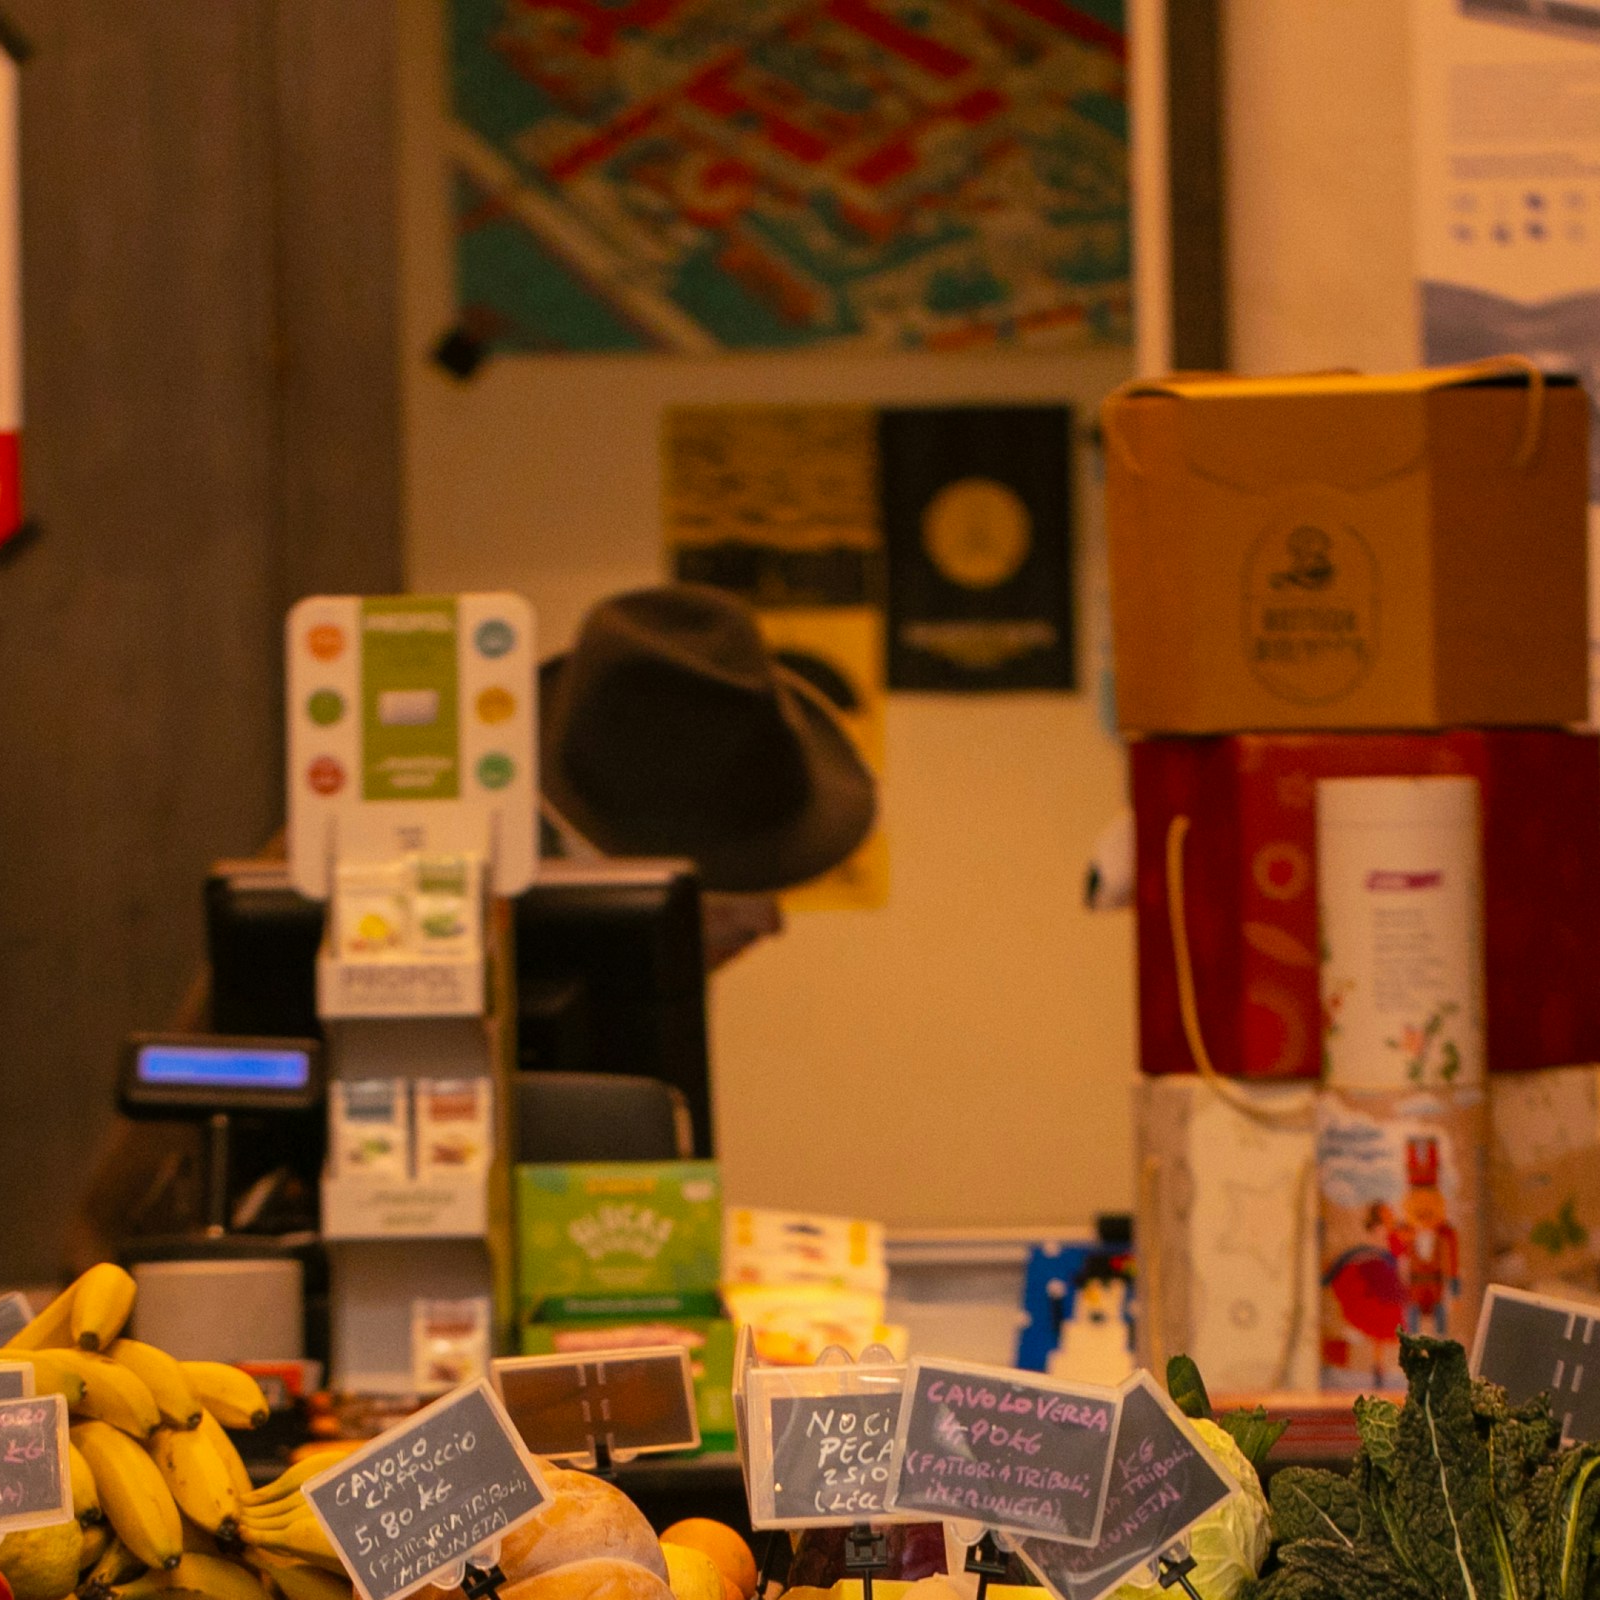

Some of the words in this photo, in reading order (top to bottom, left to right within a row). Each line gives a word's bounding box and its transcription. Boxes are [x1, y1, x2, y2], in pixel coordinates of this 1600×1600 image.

[926, 1380, 1034, 1415] CAVOLO
[817, 1437, 895, 1469] PECA
[1117, 1436, 1156, 1479] KG
[335, 1437, 428, 1507] CAVOLO
[823, 1466, 889, 1486] 25,0
[354, 1508, 414, 1557] 5,80
[418, 1478, 453, 1511] KG
[814, 1489, 883, 1513] (LECC
